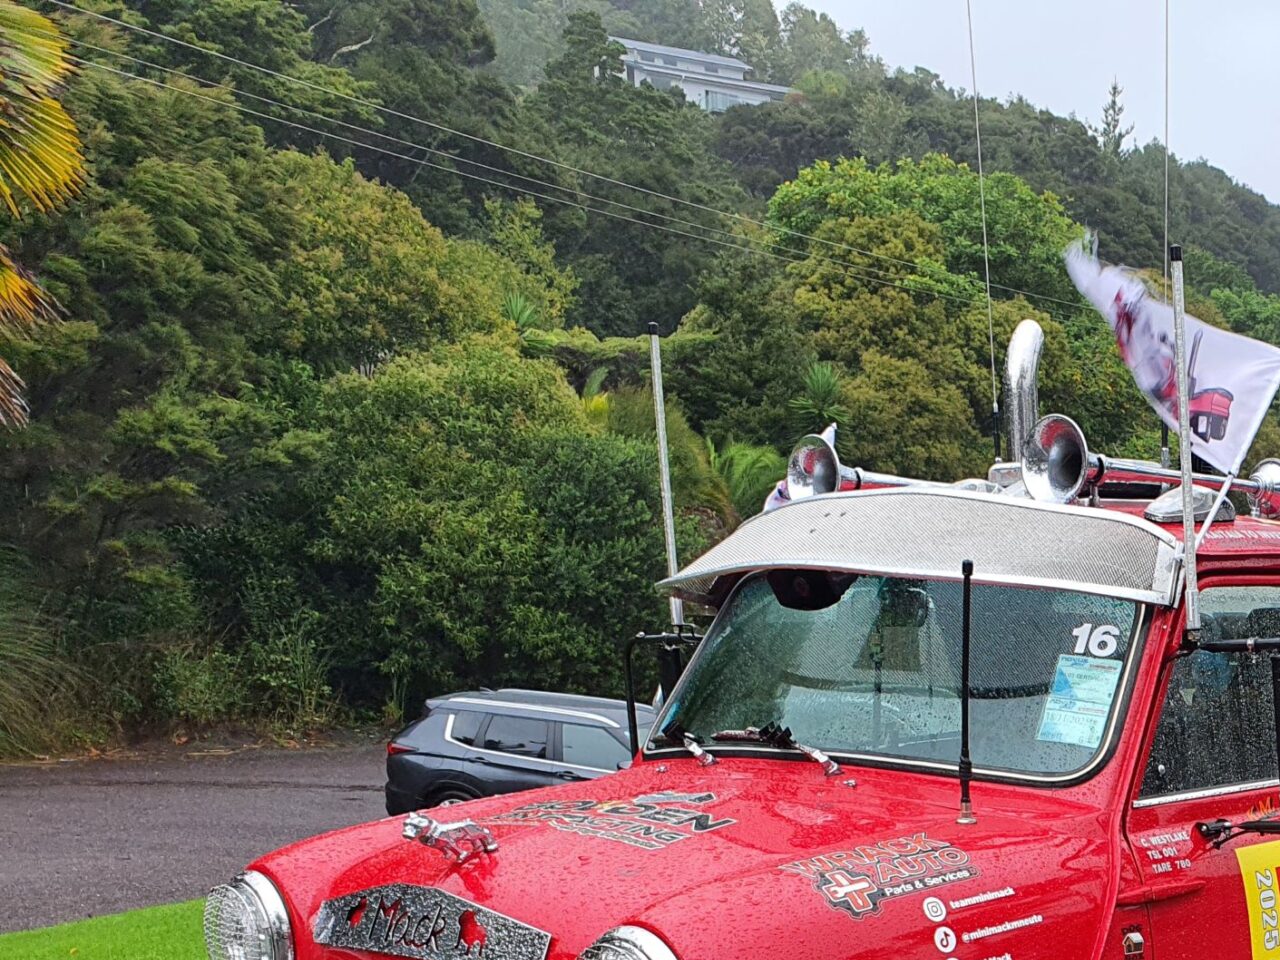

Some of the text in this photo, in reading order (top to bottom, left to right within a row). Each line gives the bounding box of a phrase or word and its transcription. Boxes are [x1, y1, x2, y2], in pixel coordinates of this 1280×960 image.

[1072, 623, 1120, 657] 16
[1150, 831, 1190, 846] WESTLAKE
[778, 832, 951, 877] WRACK
[877, 847, 970, 883] AUTO
[1146, 849, 1163, 860] TSL
[1152, 862, 1173, 874] TARE
[885, 869, 971, 897] Parts & Services
[949, 886, 1016, 910] teamminimack
[368, 894, 446, 953] Mack
[1255, 868, 1280, 951] 2025
